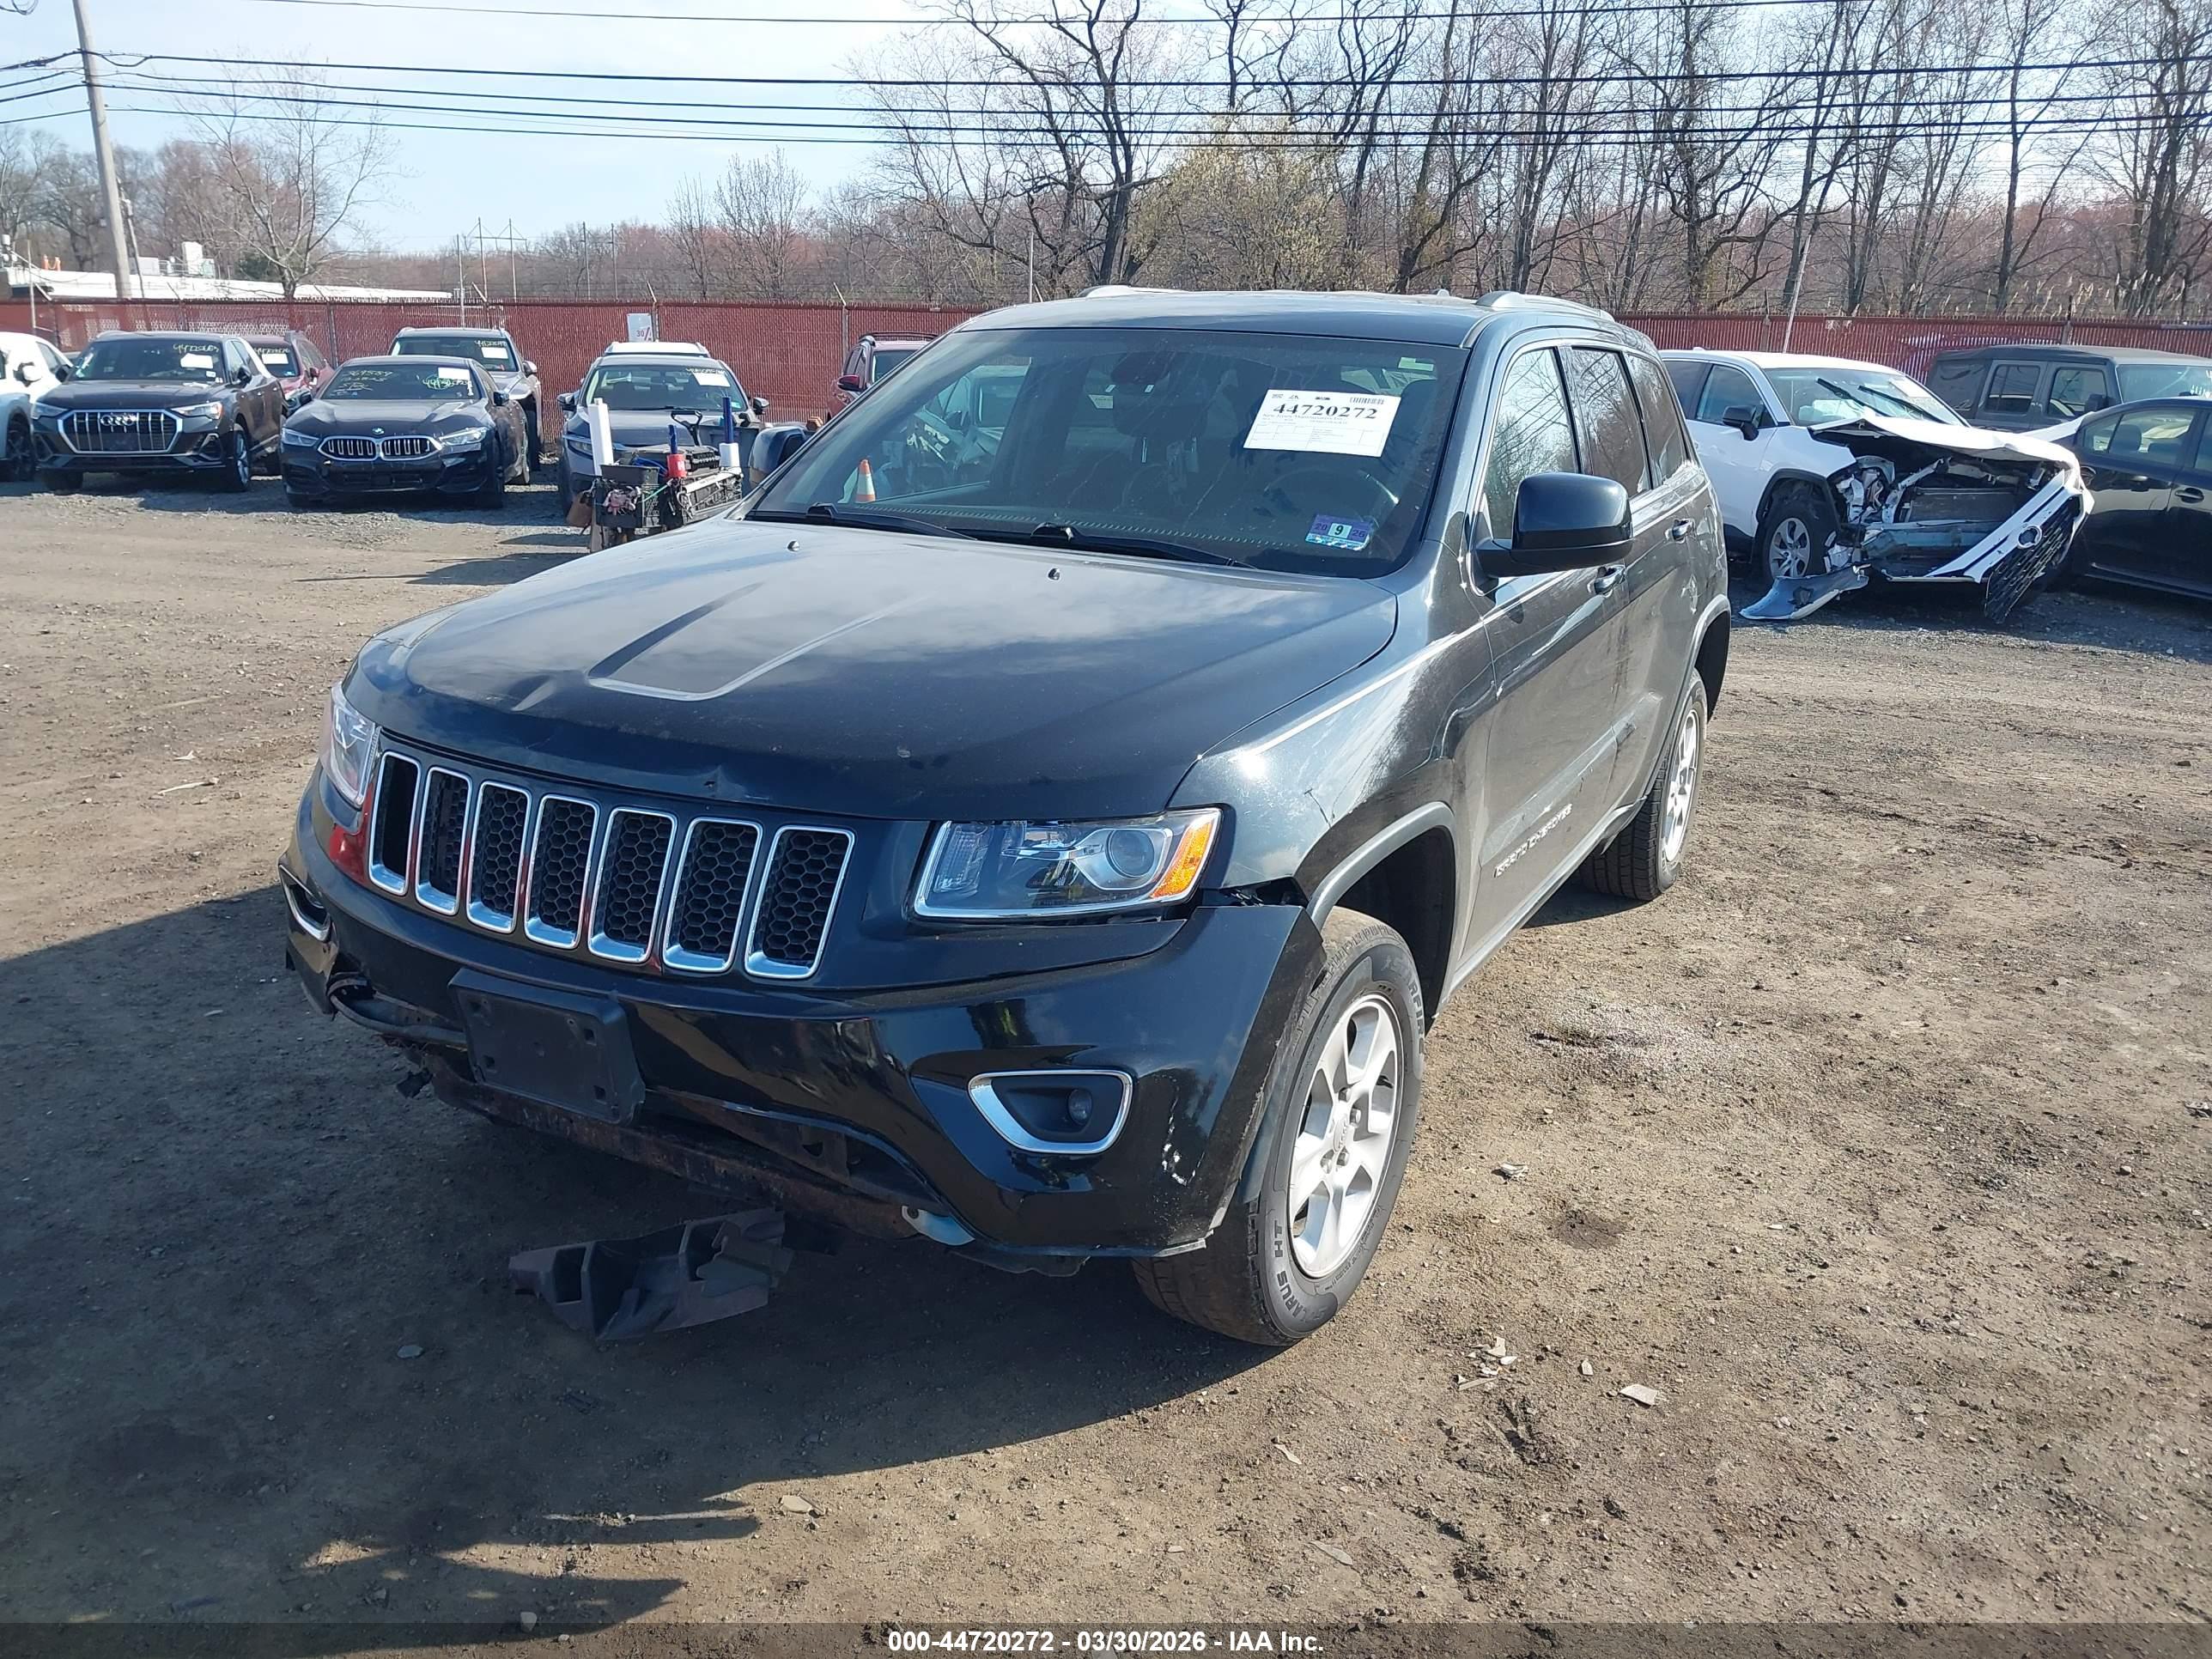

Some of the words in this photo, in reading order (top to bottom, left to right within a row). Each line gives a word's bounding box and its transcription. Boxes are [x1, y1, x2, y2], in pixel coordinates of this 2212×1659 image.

[1273, 403, 1379, 420] 44720272
[1334, 525, 1344, 536] 9
[1273, 1219, 1284, 1259] HT
